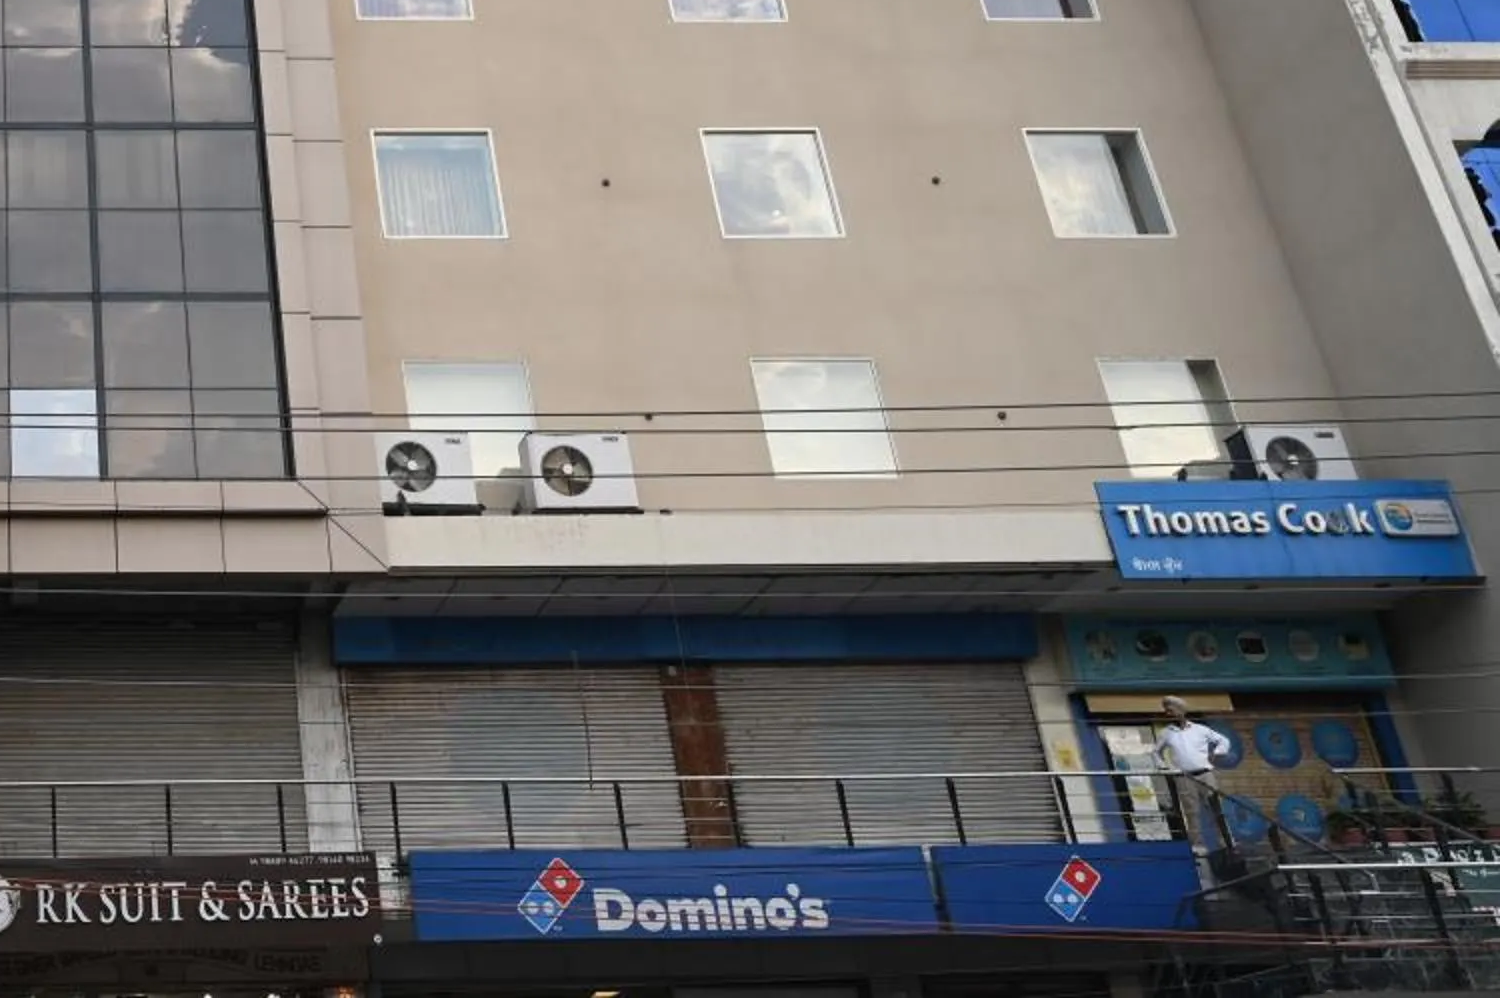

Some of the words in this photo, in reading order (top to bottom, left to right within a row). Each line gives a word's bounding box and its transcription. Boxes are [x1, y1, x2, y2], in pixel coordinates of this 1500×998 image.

[1117, 504, 1272, 536] Thomas
[35, 883, 93, 924] RK
[99, 881, 188, 924] SUIT
[198, 881, 230, 922] &
[238, 875, 370, 921] SAREES
